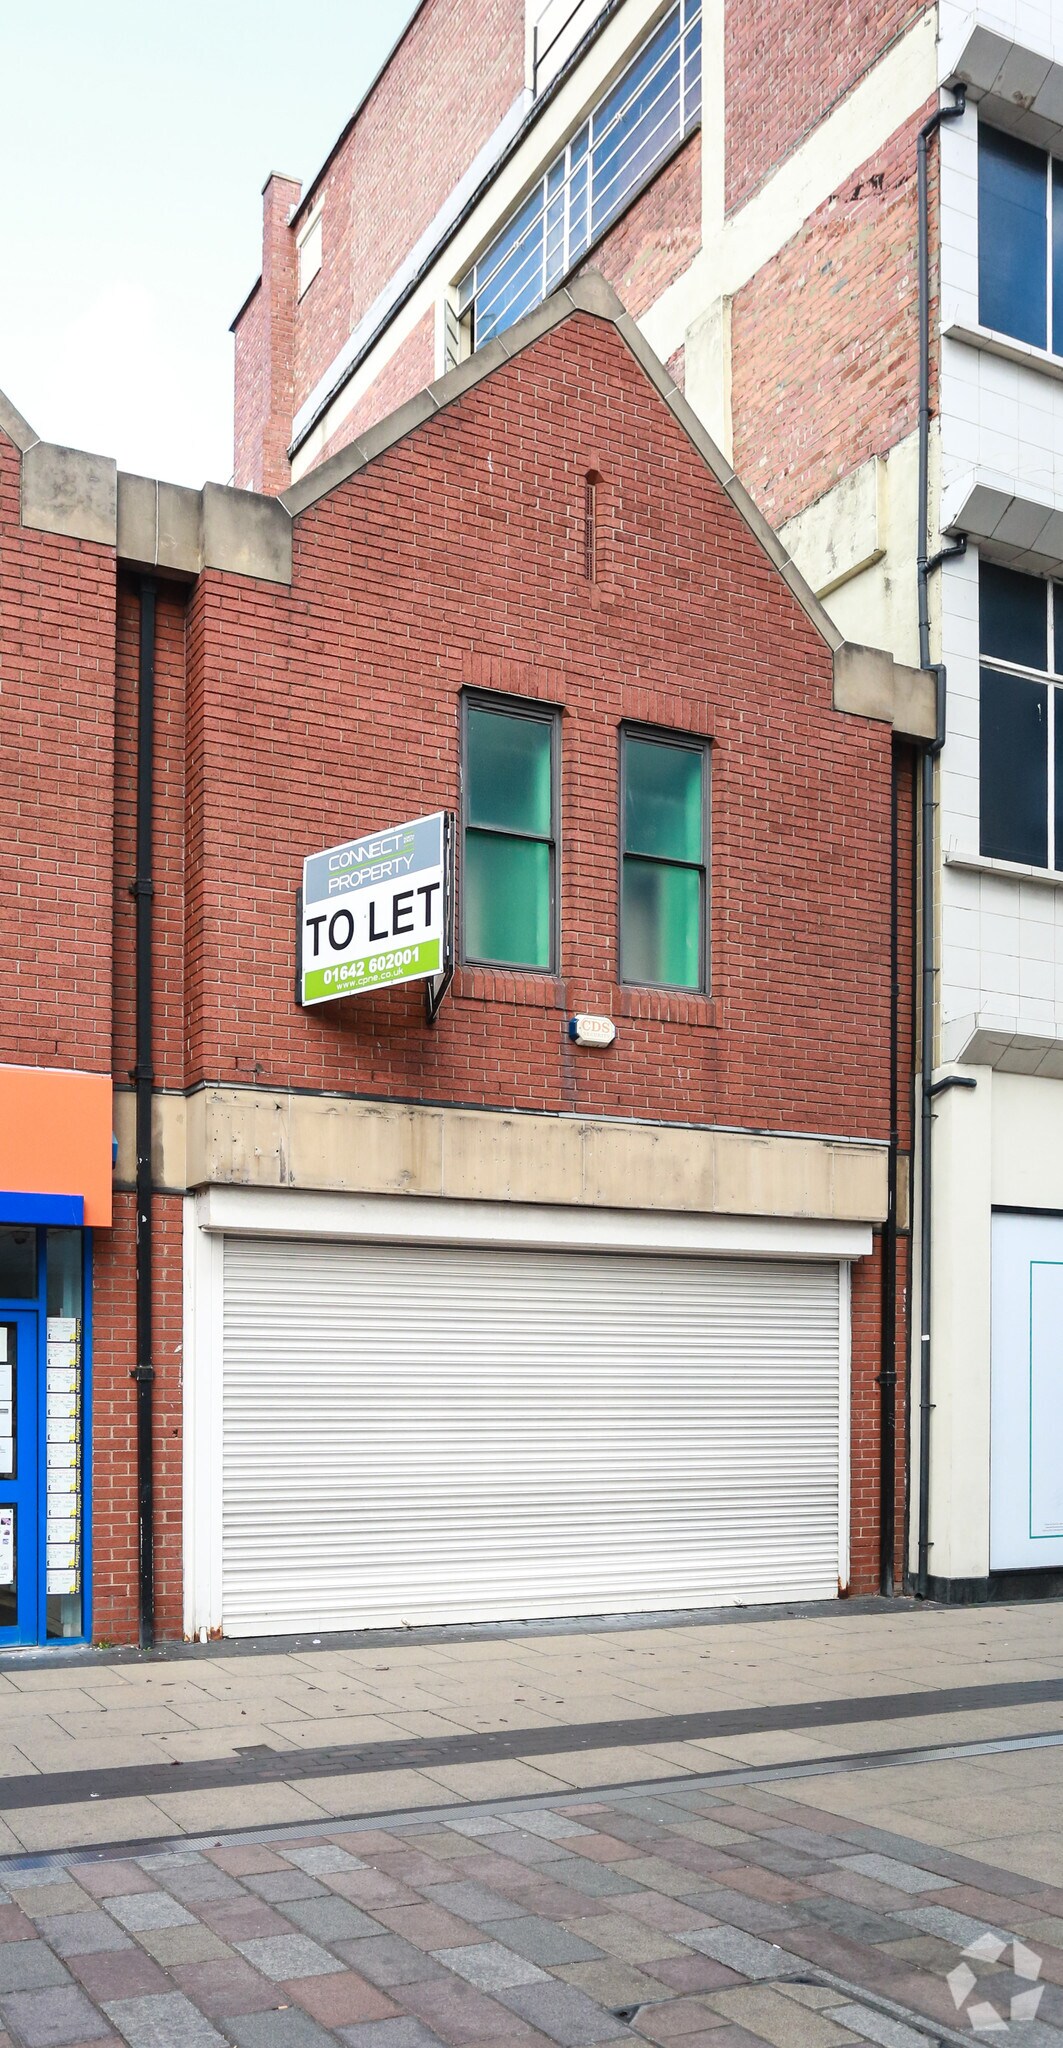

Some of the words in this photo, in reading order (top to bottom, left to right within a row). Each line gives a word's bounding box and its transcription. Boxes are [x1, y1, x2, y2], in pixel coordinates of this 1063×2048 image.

[328, 834, 403, 871] CONNECT
[328, 853, 415, 894] PROPERTY
[306, 909, 354, 956] TO
[369, 882, 440, 942] LET
[323, 961, 365, 985] 01642
[368, 946, 419, 973] 602001
[336, 967, 404, 990] www.cpne.co.uk
[583, 1020, 610, 1033] CDS
